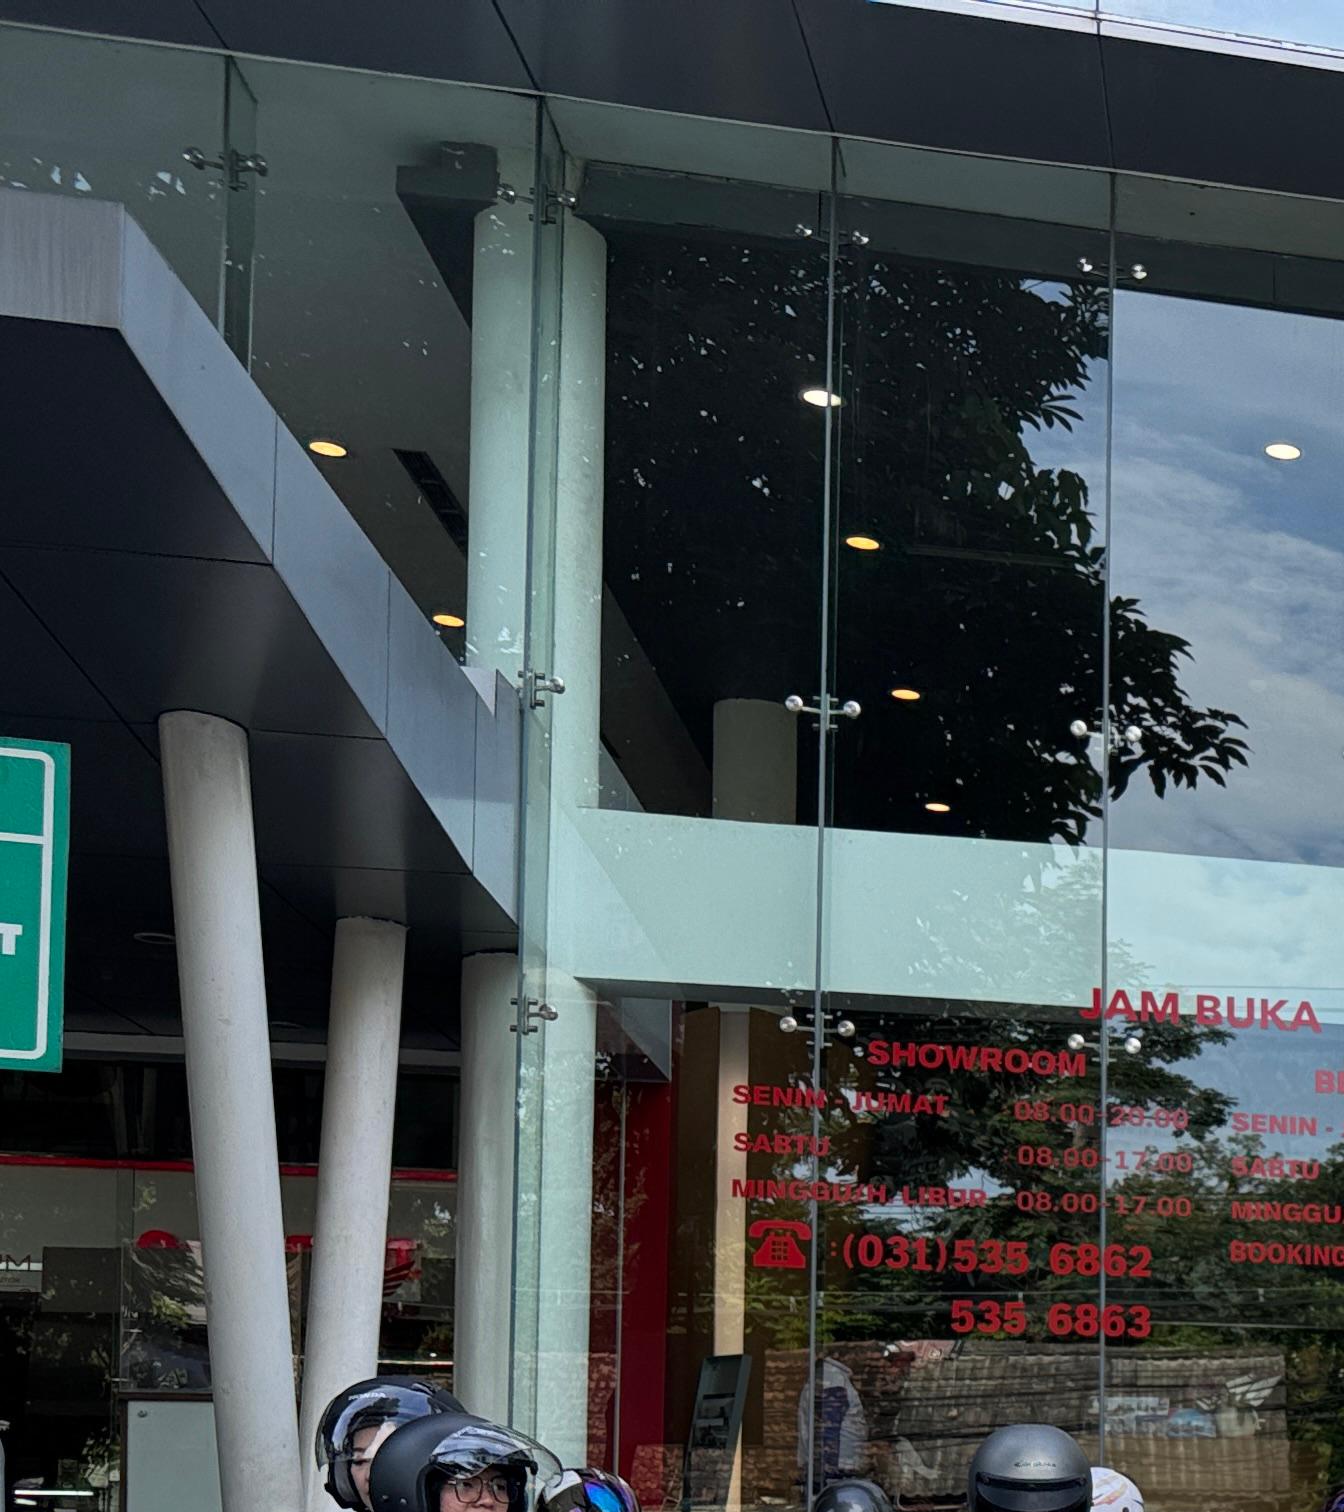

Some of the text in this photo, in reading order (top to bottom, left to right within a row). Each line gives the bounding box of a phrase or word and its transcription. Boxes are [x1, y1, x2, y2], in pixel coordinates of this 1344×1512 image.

[1079, 987, 1322, 1034] JAM BUKA
[867, 1040, 1087, 1078] SHOWROOM
[732, 1084, 826, 1109] SENIN
[851, 1092, 949, 1115] JUMAT
[1232, 1111, 1317, 1137] SENIN
[733, 1132, 1193, 1173] SABTU 08.00-17.00
[1231, 1155, 1320, 1181] SABTU
[902, 1186, 988, 1209] LIBUR
[1016, 1190, 1193, 1218] 08.00-17.00
[1048, 1242, 1153, 1278] 6862
[950, 1300, 1152, 1338] 535 6863
